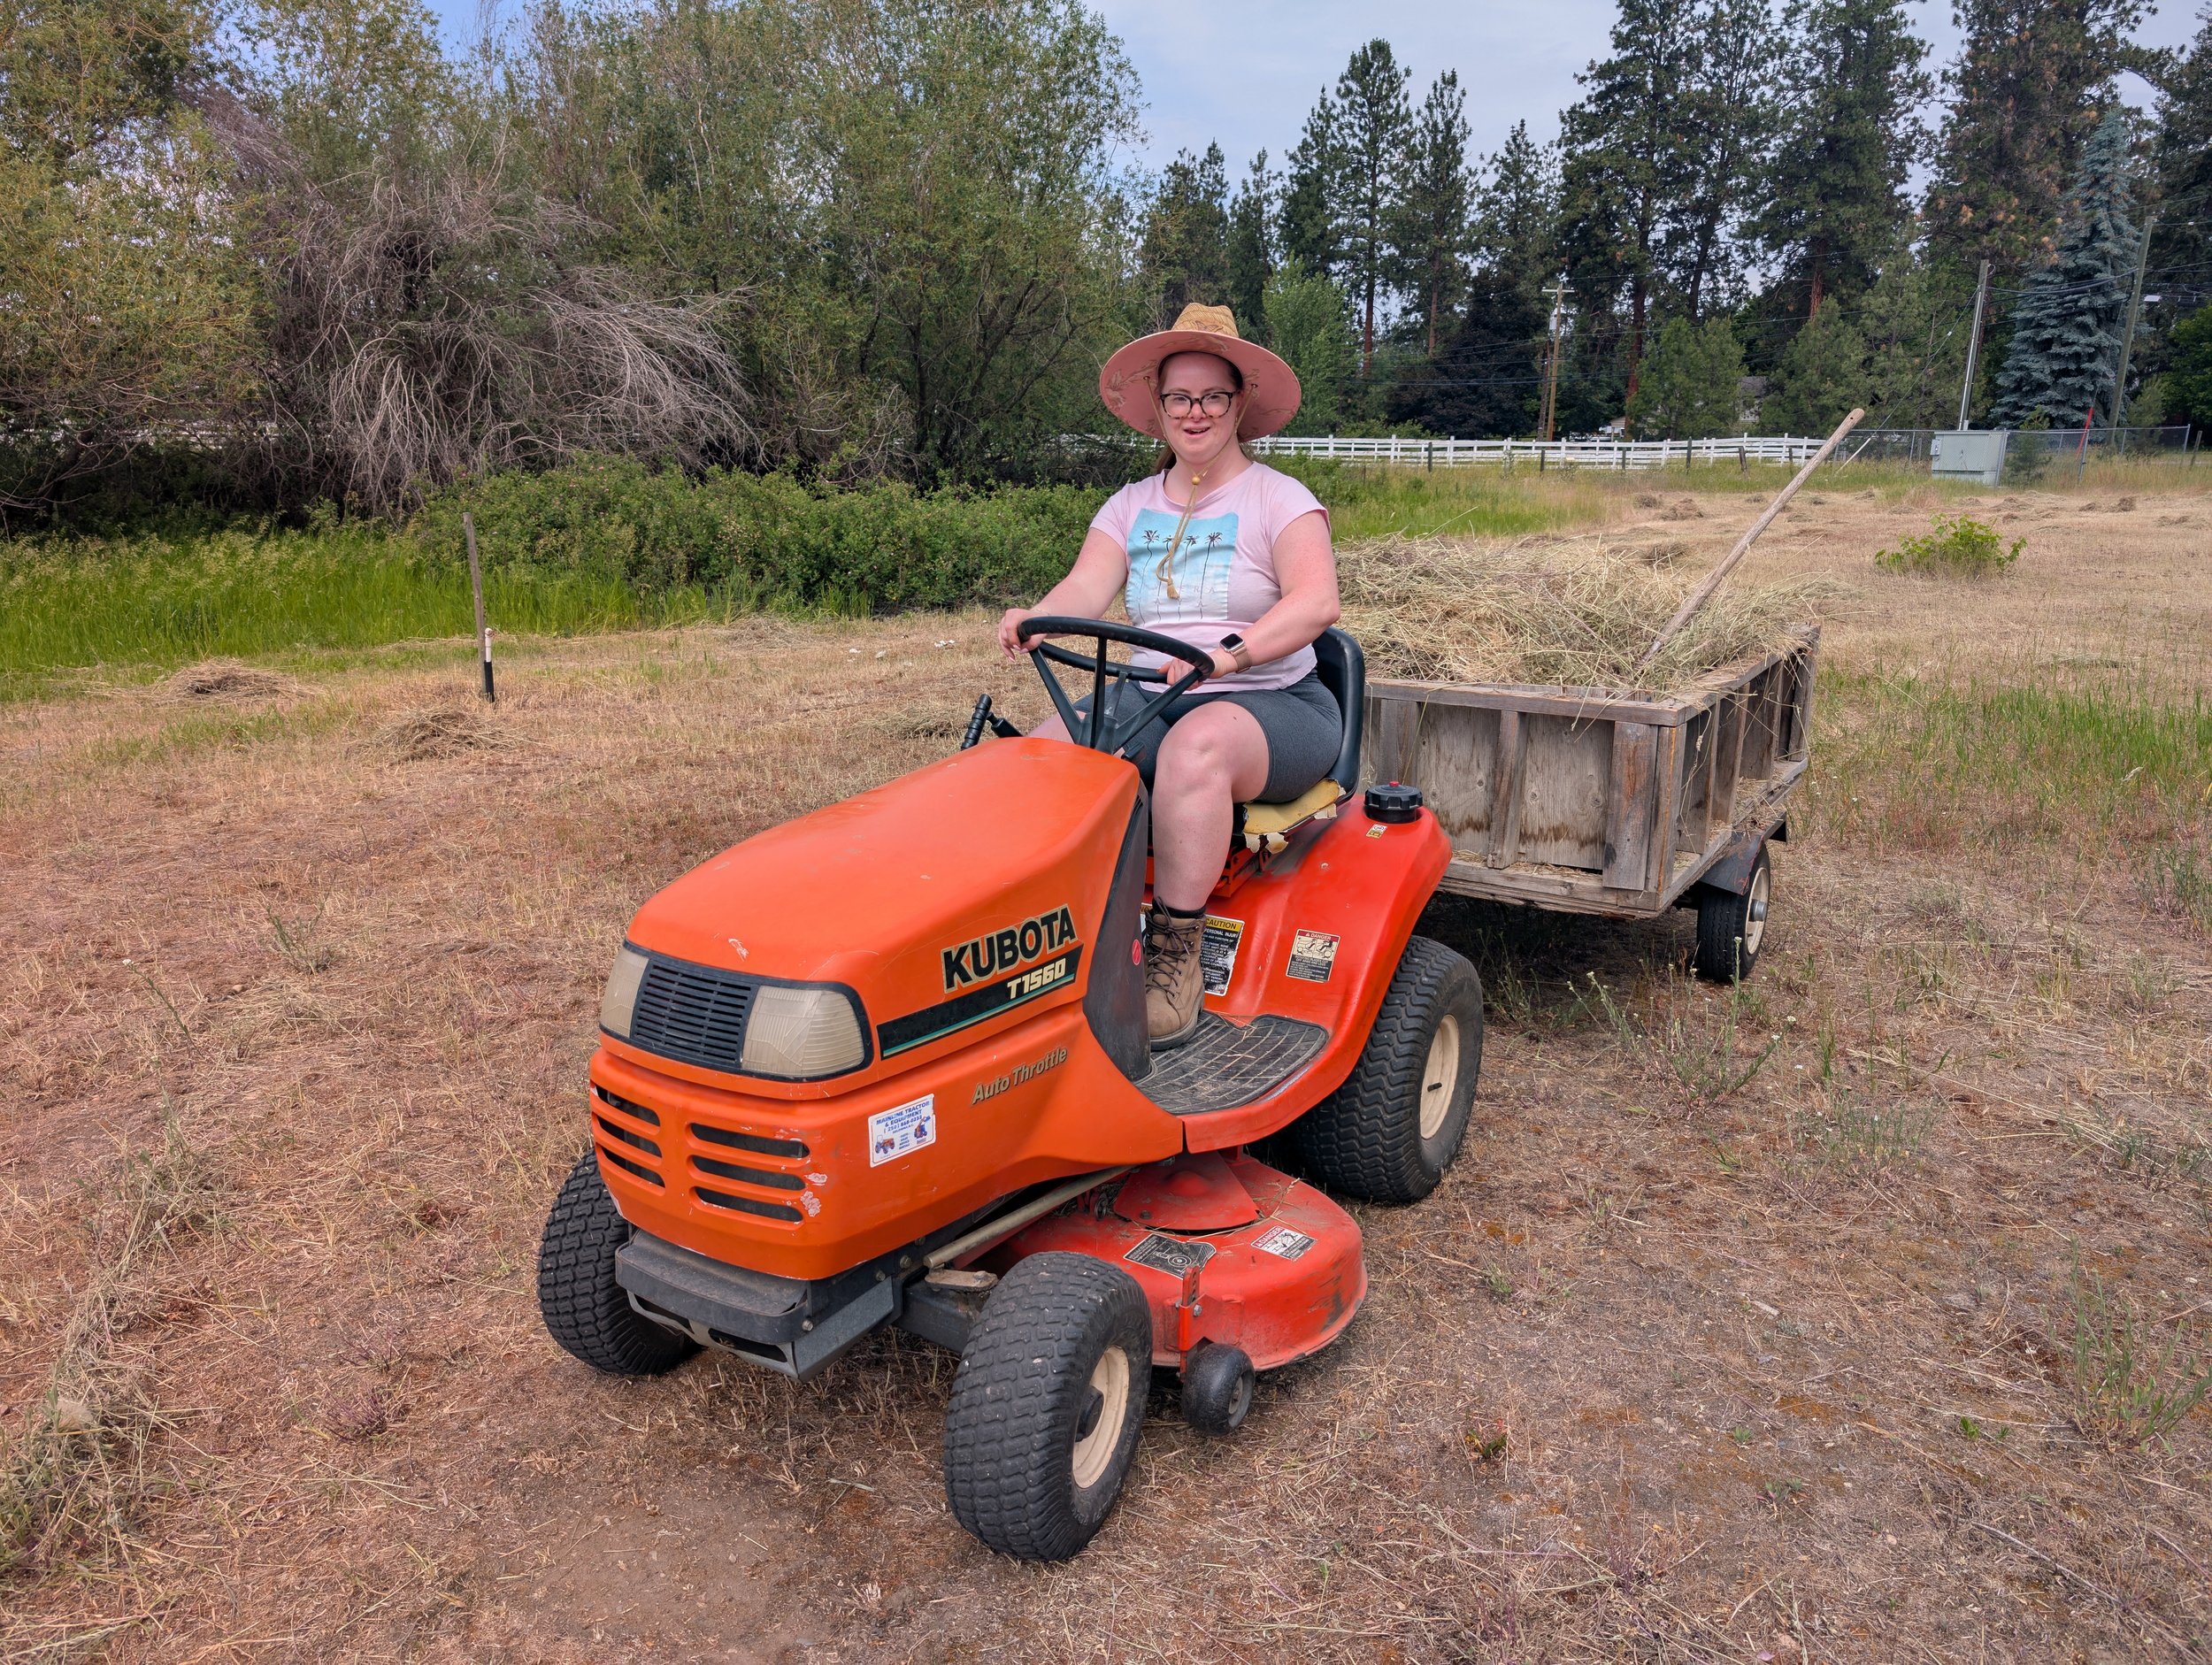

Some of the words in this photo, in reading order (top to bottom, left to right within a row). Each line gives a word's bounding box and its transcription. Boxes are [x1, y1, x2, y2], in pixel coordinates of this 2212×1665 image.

[1205, 917, 1237, 930] CAUTION
[941, 904, 1078, 993] KUBOTA
[1007, 958, 1066, 1000] T1560
[972, 1076, 1010, 1105] Auto
[1011, 1047, 1067, 1086] Throttle
[877, 1111, 903, 1124] MAINLINE
[904, 1101, 930, 1114] TRACTOR
[890, 1109, 923, 1125] EQUIPMENT
[1260, 1227, 1283, 1246] DANGER
